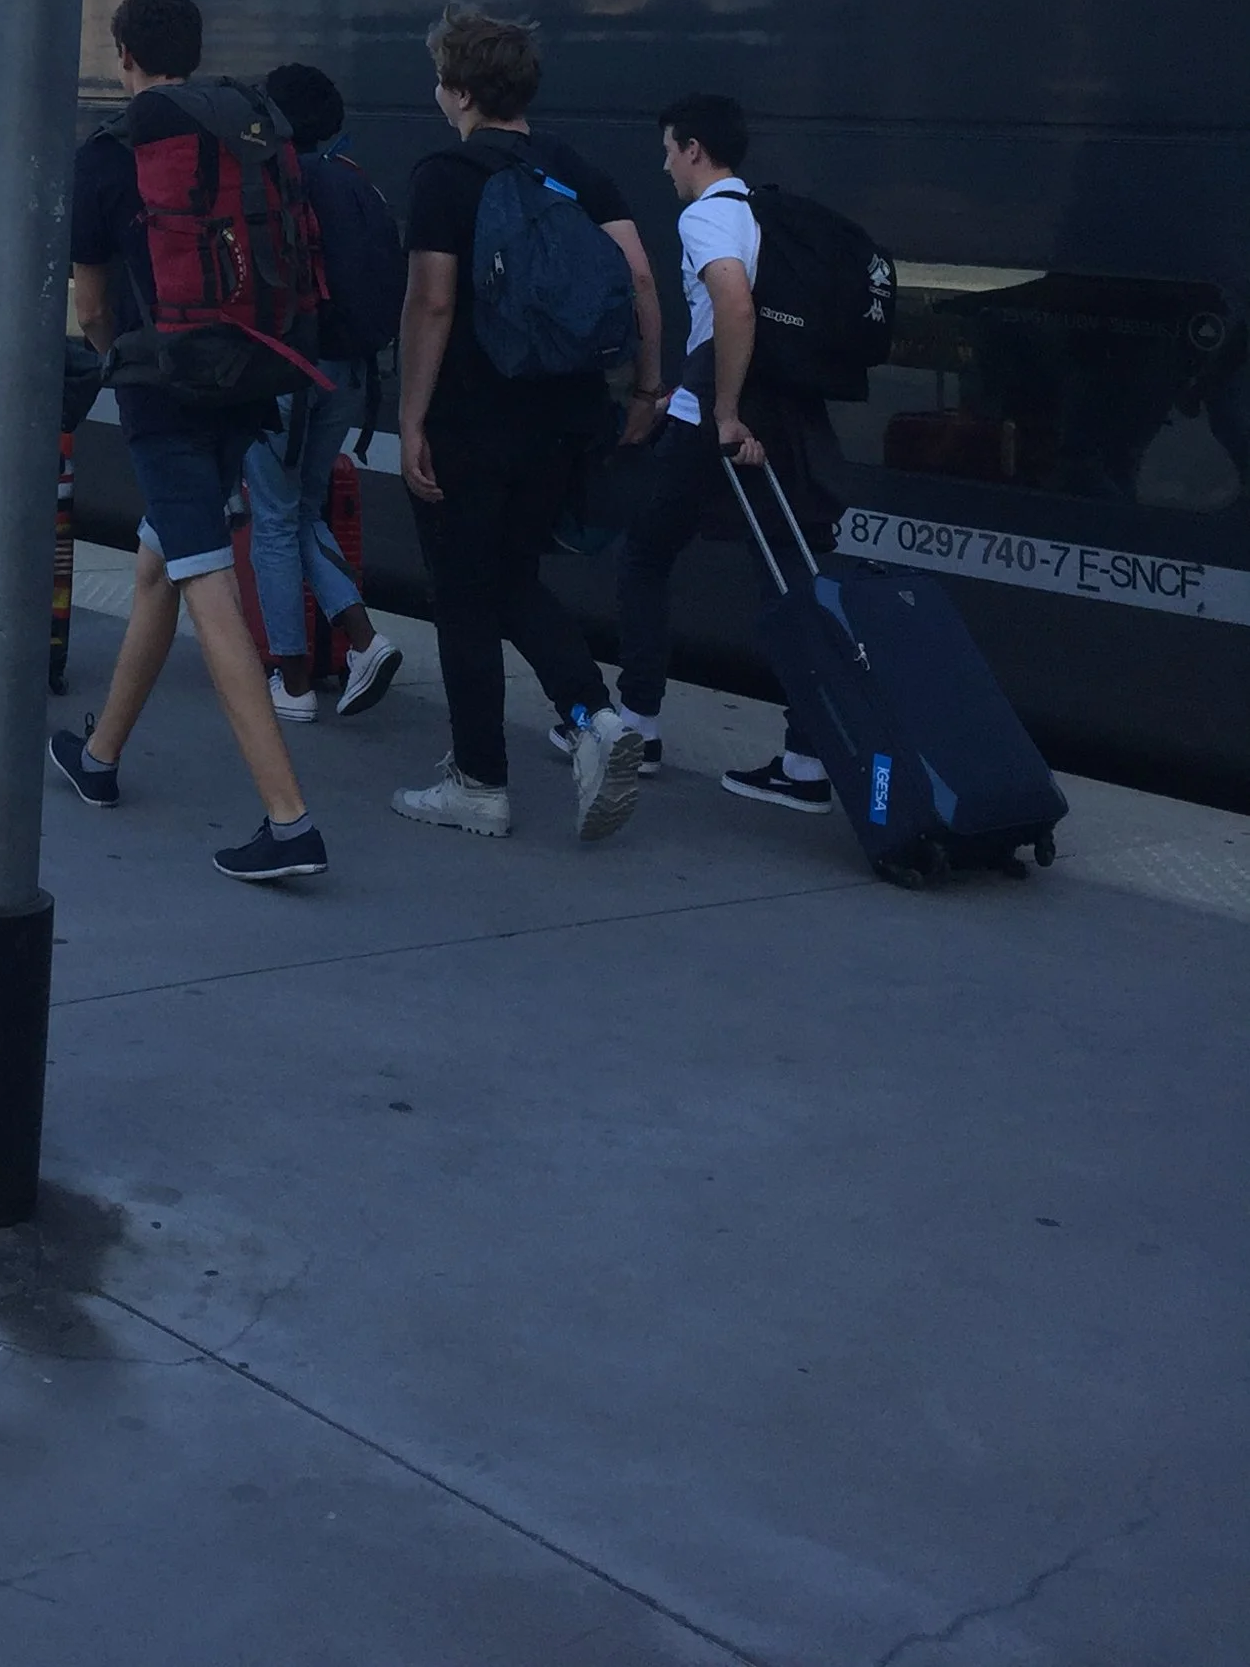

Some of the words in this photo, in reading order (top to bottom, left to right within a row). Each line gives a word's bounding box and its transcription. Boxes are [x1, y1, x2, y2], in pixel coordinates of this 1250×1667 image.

[758, 305, 806, 328] Kappa
[850, 512, 889, 546] 87
[874, 766, 890, 811] IGESA
